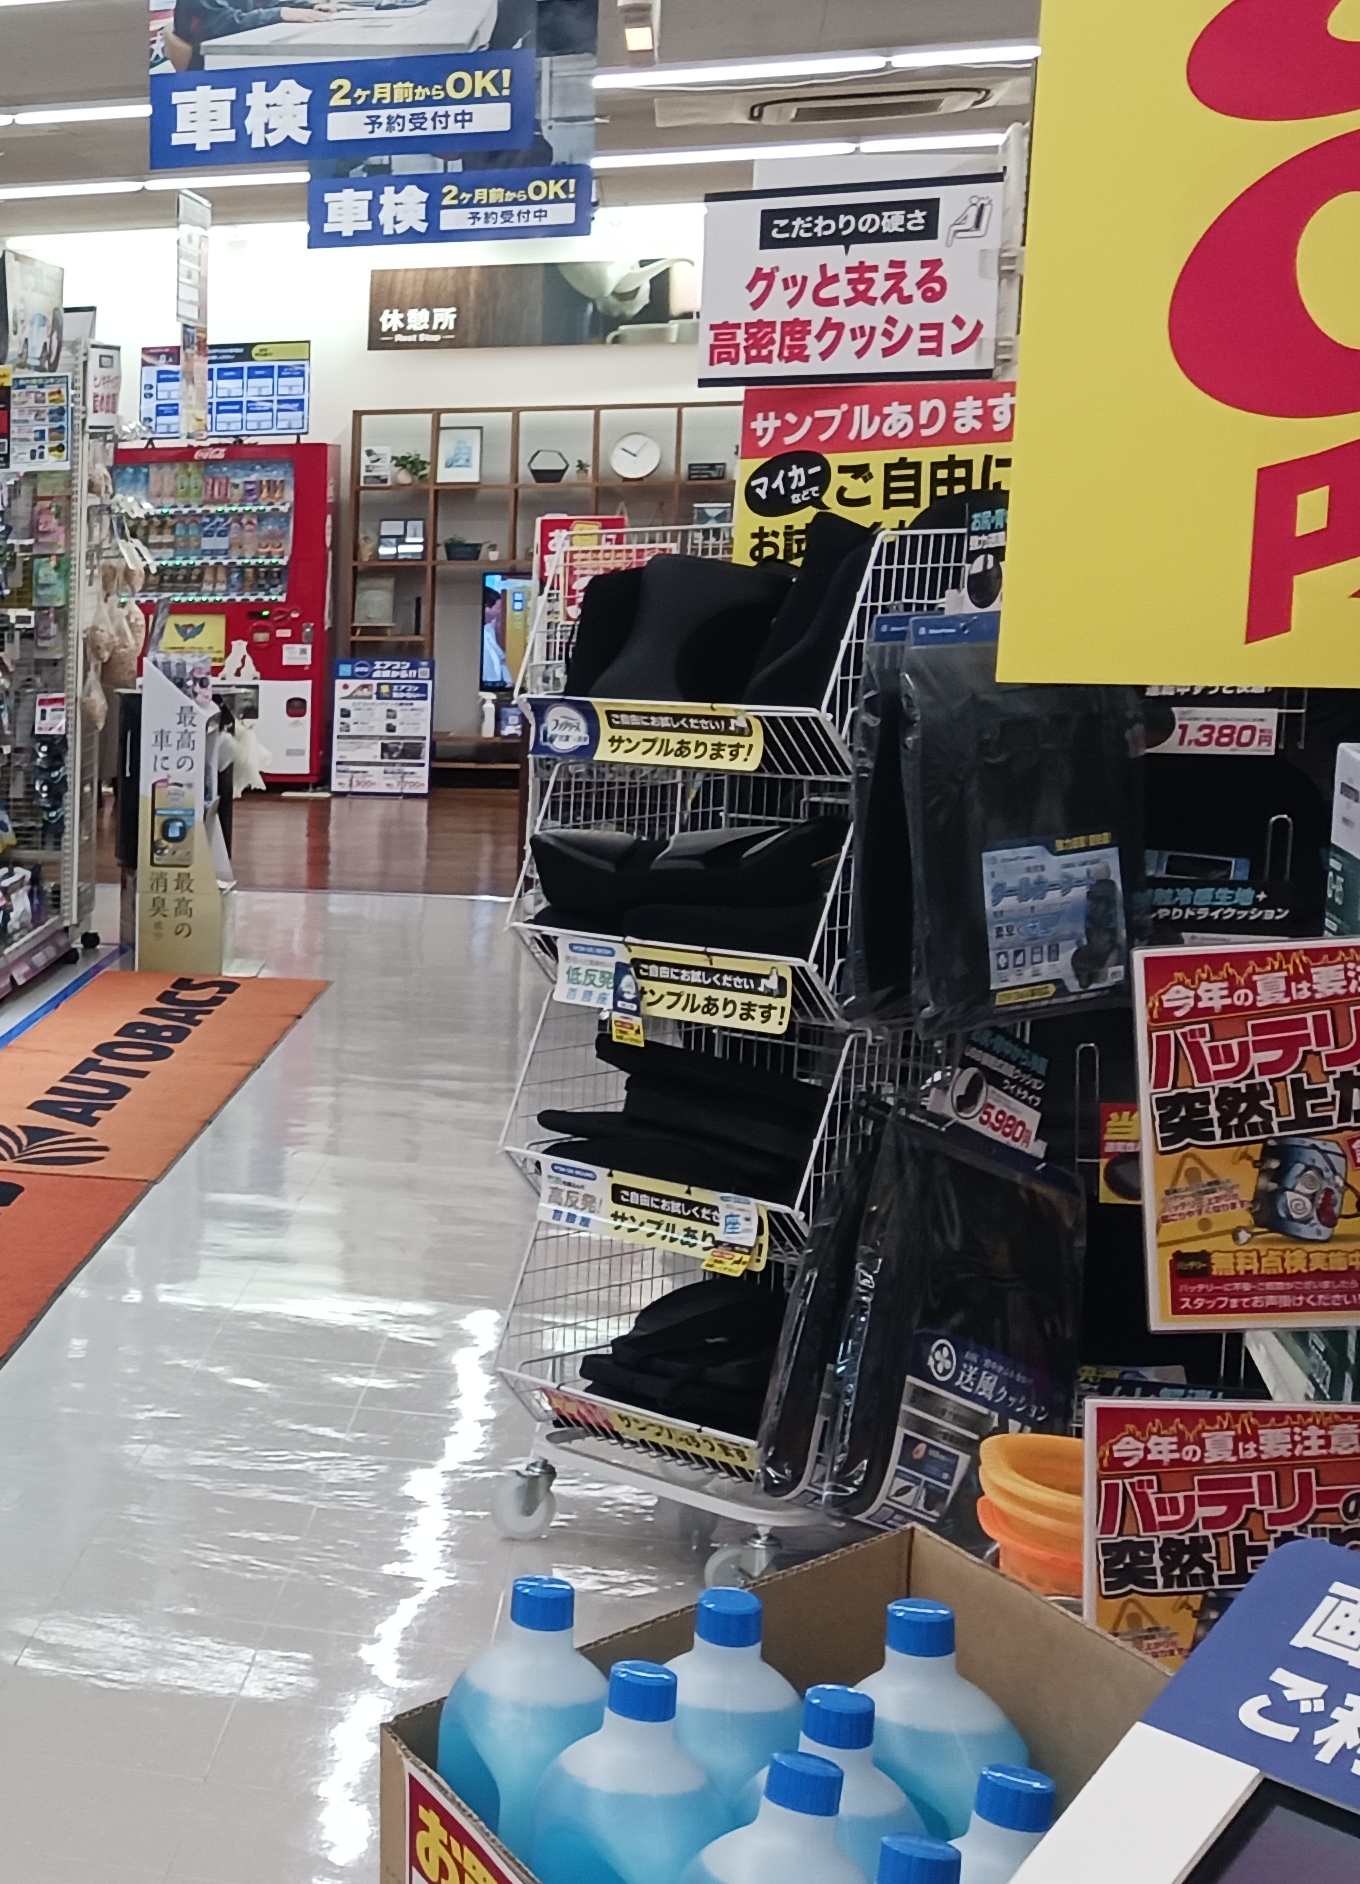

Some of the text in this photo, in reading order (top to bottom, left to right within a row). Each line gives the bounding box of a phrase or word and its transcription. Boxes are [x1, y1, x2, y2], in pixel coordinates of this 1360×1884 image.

[171, 68, 513, 152] 車検 2ヶ月前からOK!
[363, 109, 474, 134] 予約受付中
[322, 178, 577, 237] 車検 2ヶ月前からOK!
[466, 206, 549, 227] 予約受付中
[770, 210, 928, 240] こだわりの硬さ
[745, 257, 949, 311] グッと支える
[380, 307, 458, 333] 休憩所
[708, 317, 984, 368] 高密度クッション
[750, 463, 823, 502] マイカー
[373, 660, 411, 670] エアコン
[152, 728, 173, 773] 車に
[175, 705, 197, 774] 最高の
[607, 733, 754, 763] サンプルあります!
[148, 872, 169, 919] 消臭
[173, 872, 195, 940] 最高の
[565, 965, 615, 991] 低反発
[25, 977, 242, 1128] AUTOBACS
[722, 1210, 743, 1235] 座
[954, 1362, 1051, 1422] 送風クッション
[1112, 1425, 1360, 1468] 今年の夏は要注意
